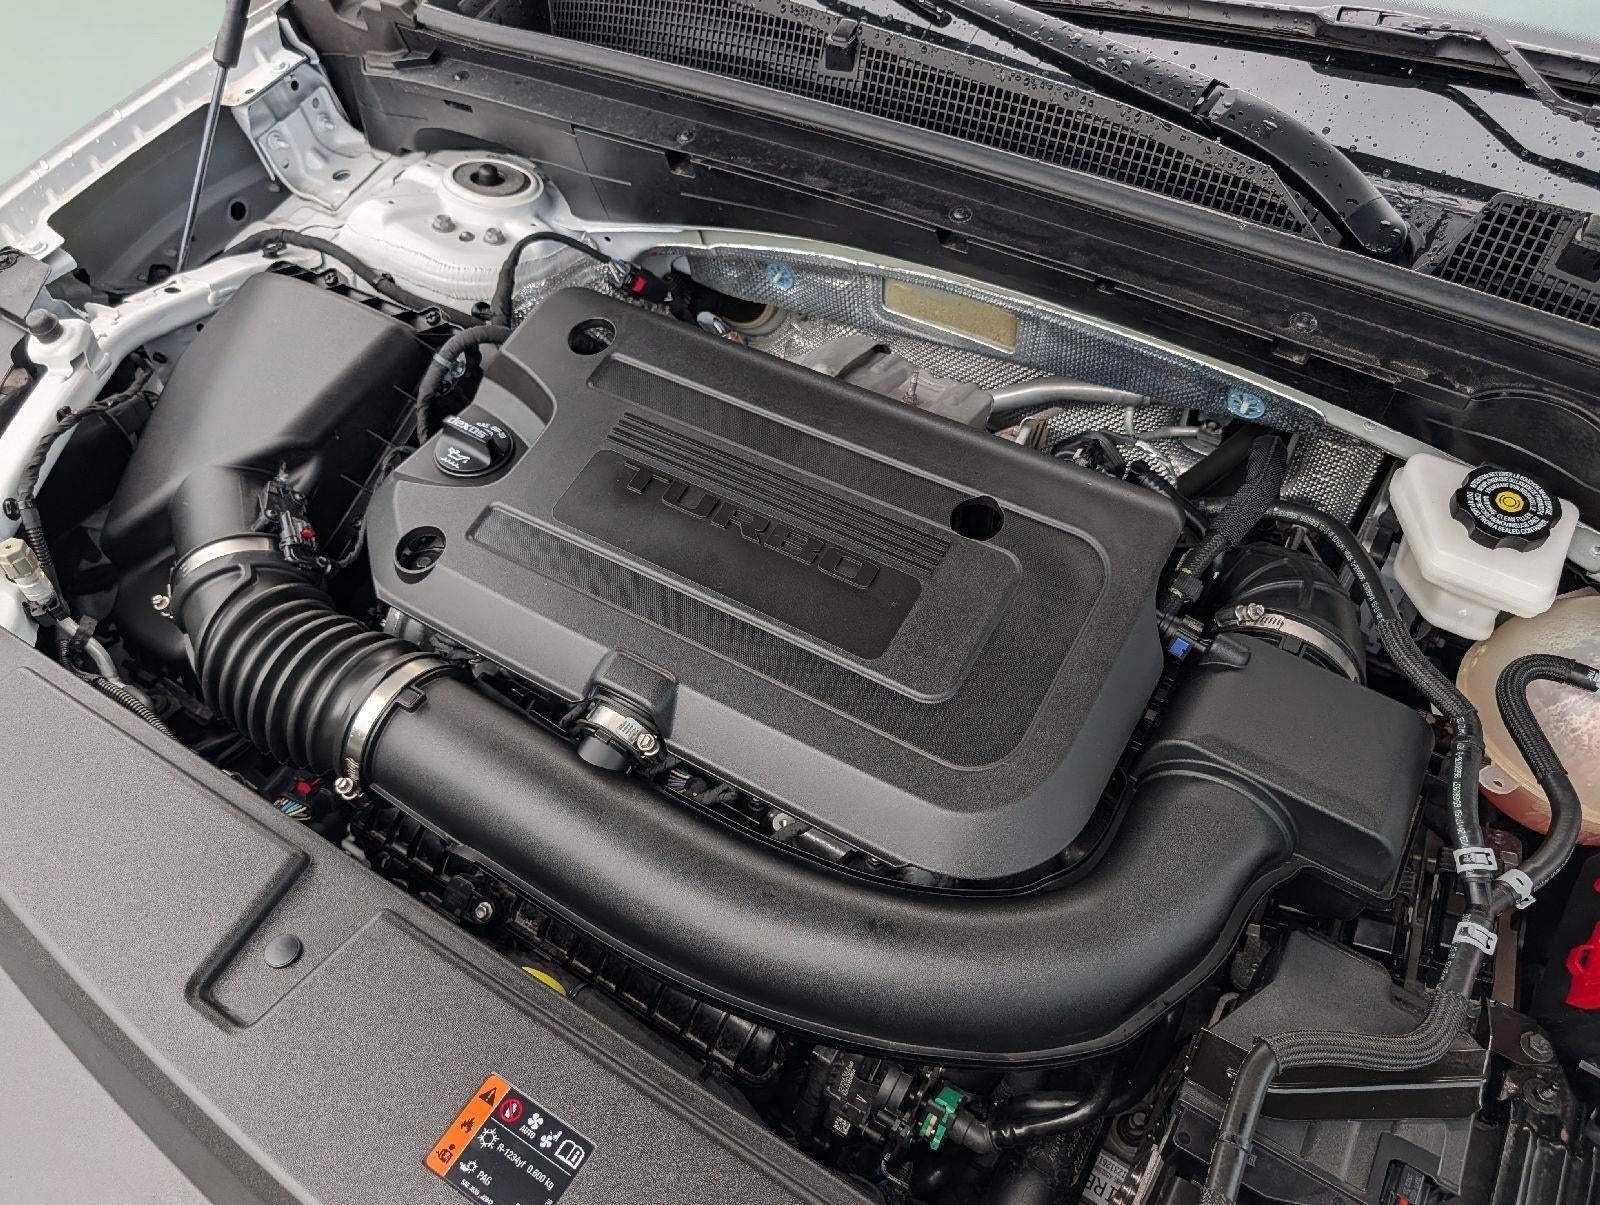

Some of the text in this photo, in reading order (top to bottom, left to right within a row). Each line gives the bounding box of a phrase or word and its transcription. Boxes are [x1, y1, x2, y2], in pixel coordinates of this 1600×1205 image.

[623, 460, 880, 590] TURBO
[519, 1125, 536, 1139] AUTO
[476, 1170, 493, 1187] PAG
[496, 1143, 527, 1169] R-1234yf
[543, 1178, 555, 1191] kg
